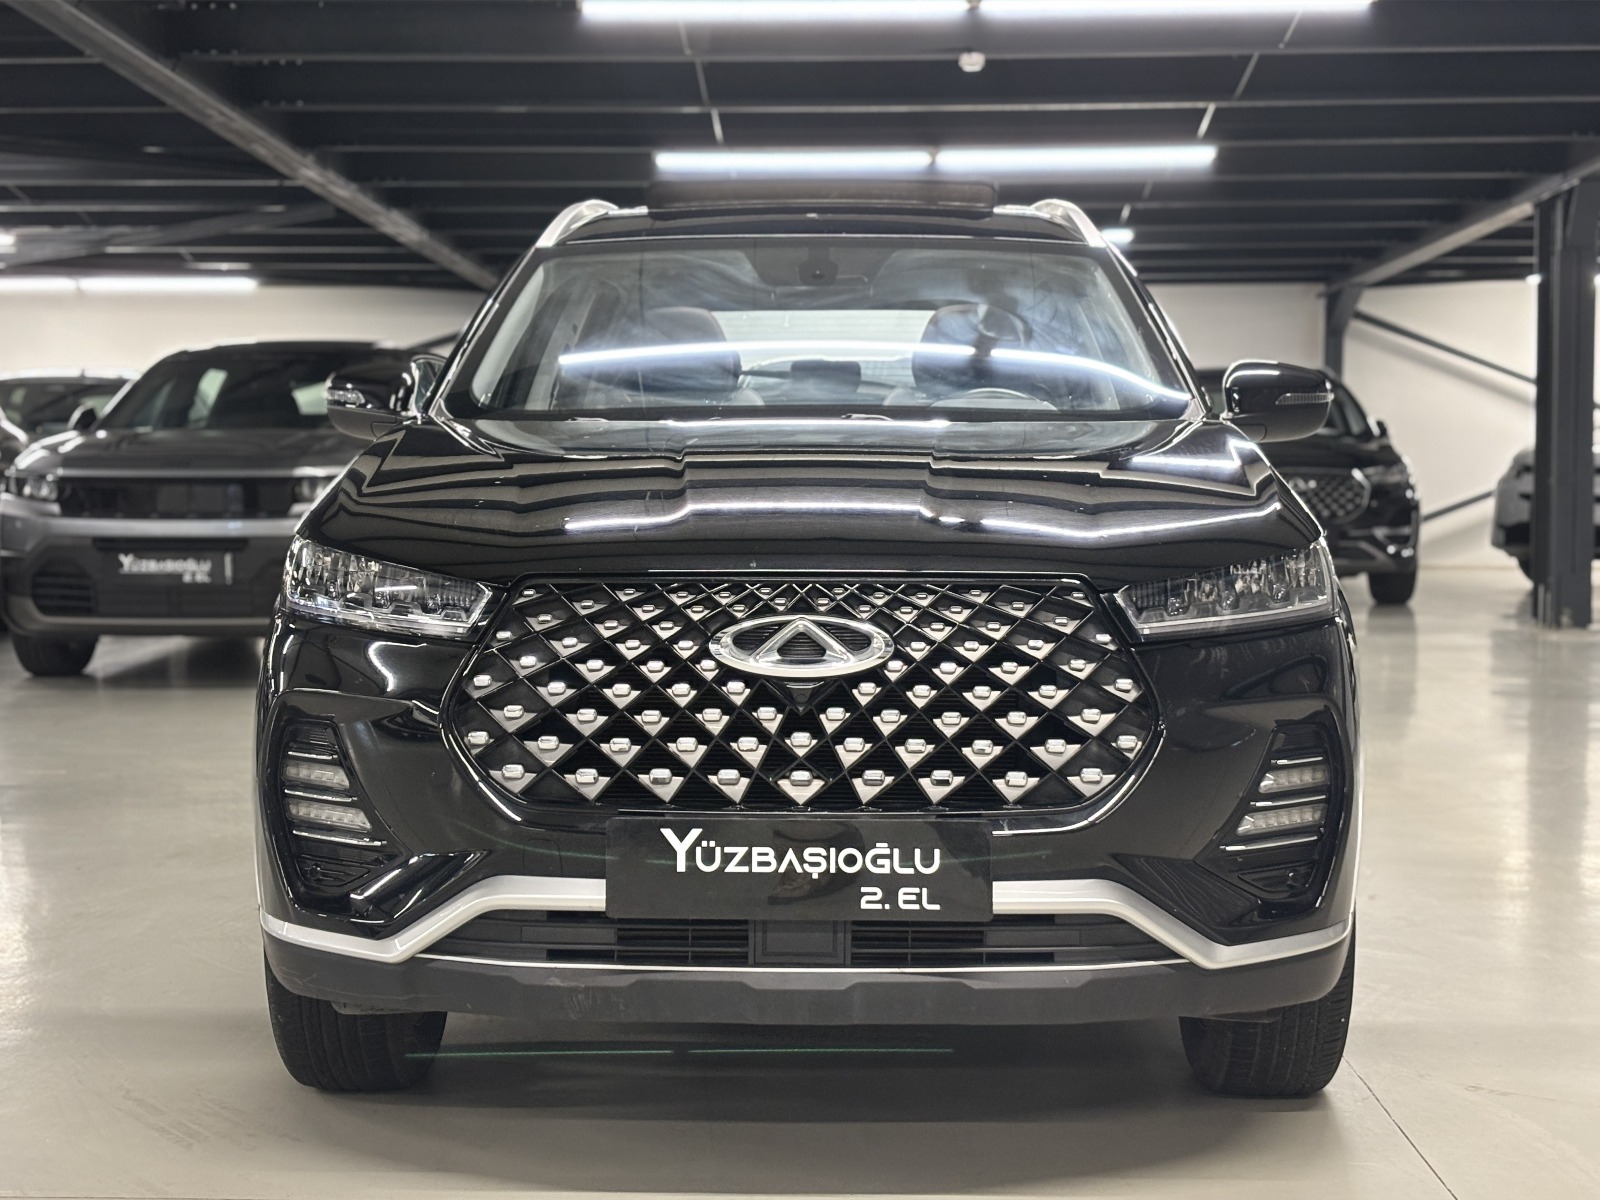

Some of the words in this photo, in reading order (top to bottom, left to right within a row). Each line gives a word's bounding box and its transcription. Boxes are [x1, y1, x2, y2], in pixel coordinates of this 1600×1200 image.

[660, 828, 941, 879] YÜZBAŞIOĞLU
[860, 886, 890, 910] 2.
[898, 886, 941, 910] EL
